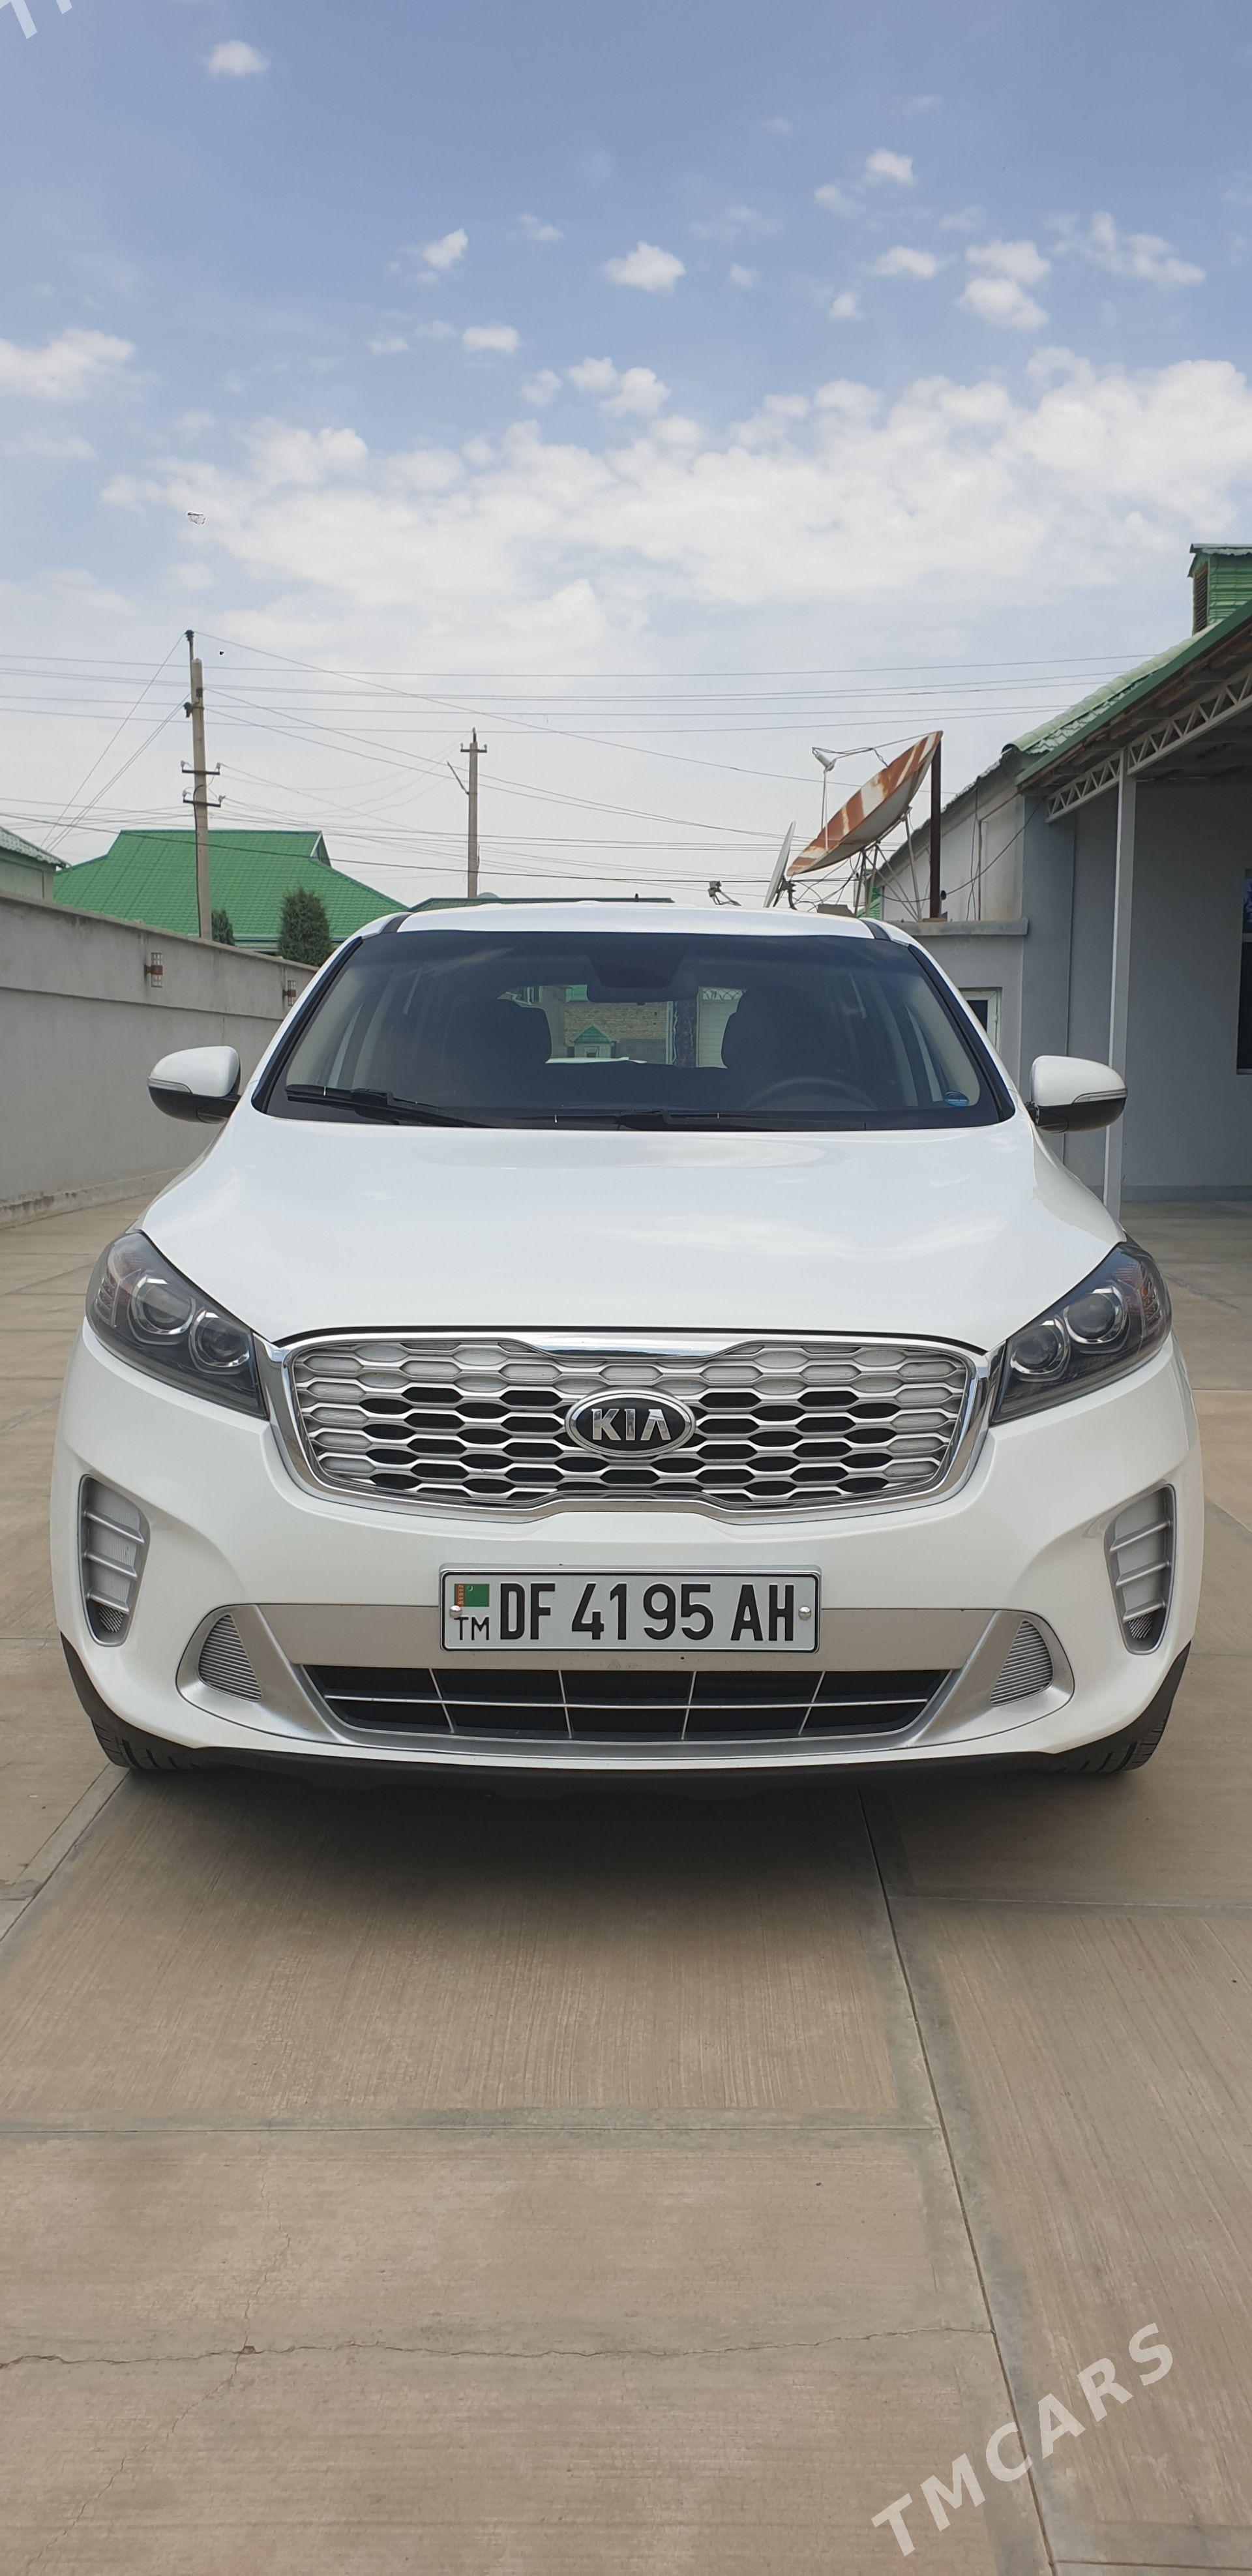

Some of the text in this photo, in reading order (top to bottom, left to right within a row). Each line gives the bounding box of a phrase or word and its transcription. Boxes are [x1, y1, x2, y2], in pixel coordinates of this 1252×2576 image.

[591, 1408, 672, 1441] KIA
[454, 1616, 490, 1641] TM
[499, 1583, 556, 1641] DF
[730, 1584, 794, 1641] AH
